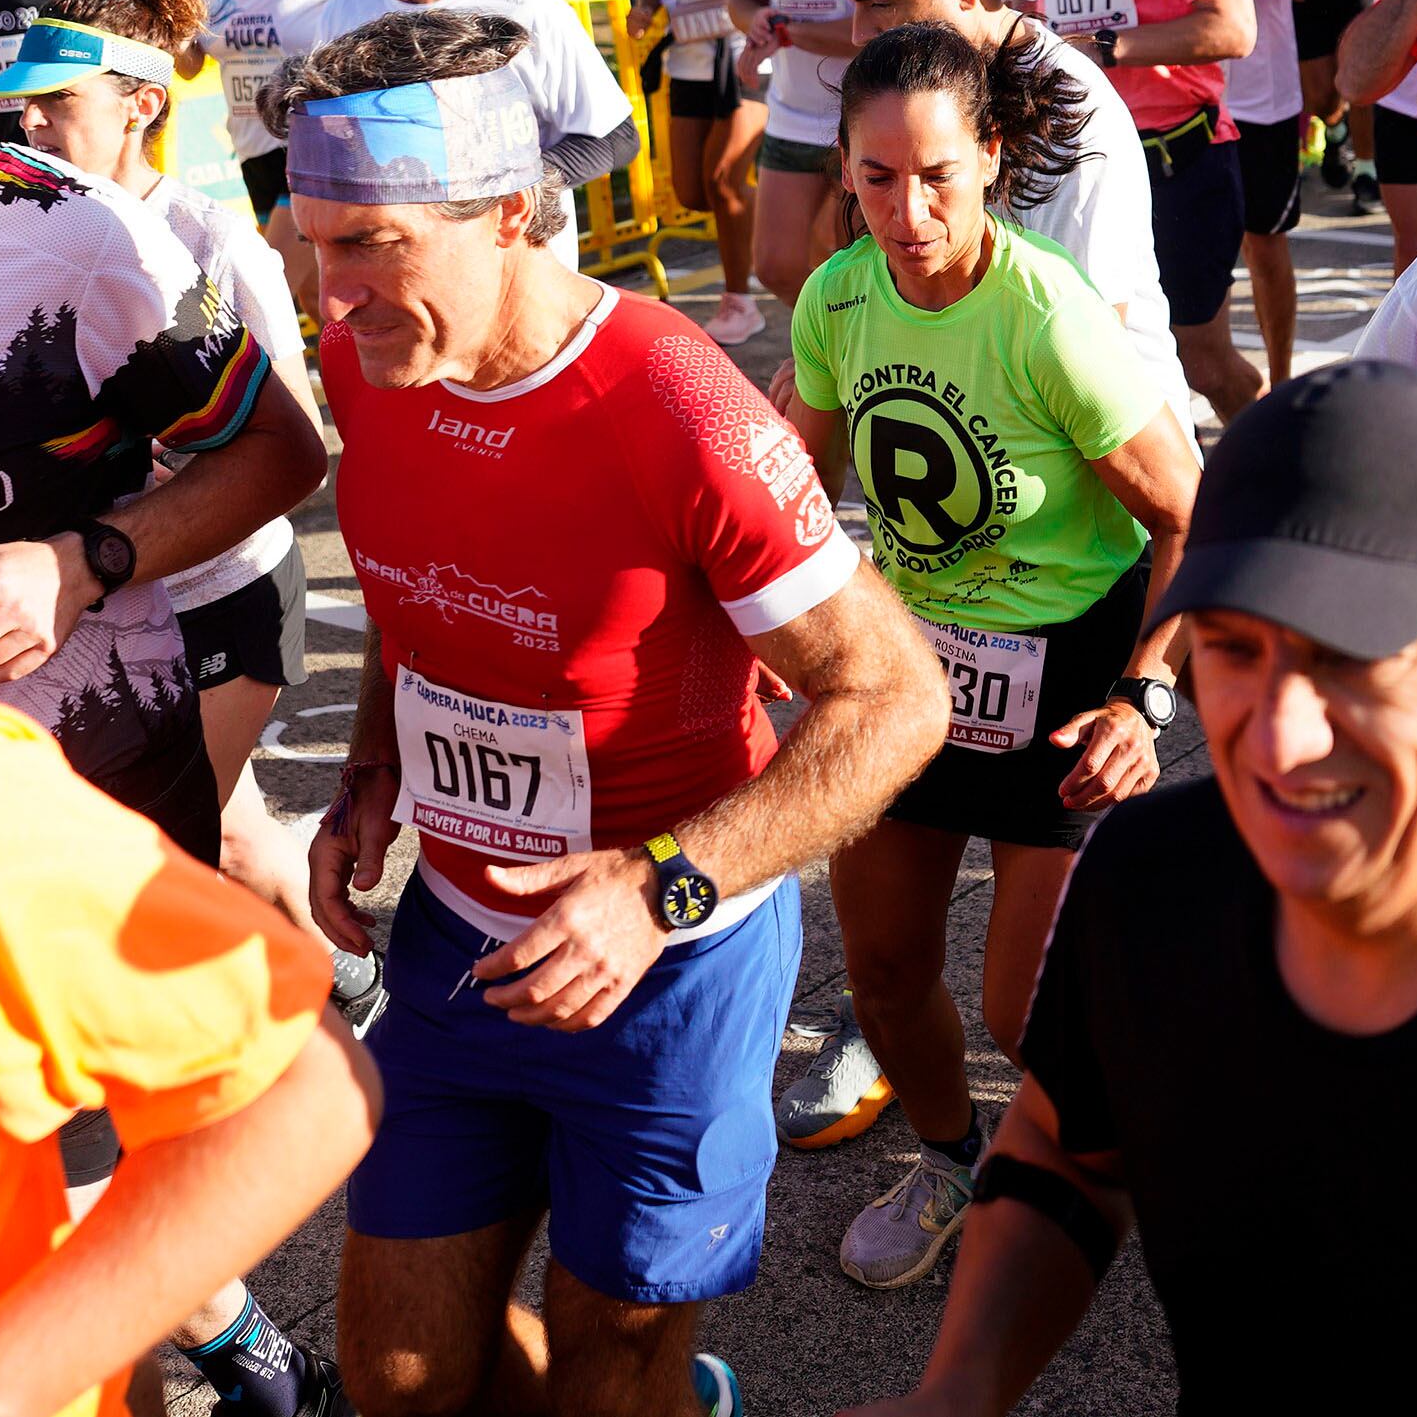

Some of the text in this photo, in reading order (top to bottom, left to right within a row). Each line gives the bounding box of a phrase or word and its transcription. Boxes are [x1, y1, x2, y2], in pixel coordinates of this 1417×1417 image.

[225, 26, 281, 50] HUCA
[427, 409, 516, 449] land
[851, 363, 1018, 518] CONTRA EL CANCER
[454, 441, 504, 460] EVENTS
[870, 413, 963, 548] R
[896, 524, 1008, 575] SOLIDARIO
[450, 590, 465, 602] de
[512, 631, 561, 652] 2023
[935, 638, 978, 664] ROSINA
[990, 636, 1021, 652] 2023
[417, 680, 548, 730] CARRERA HUCA 2023
[938, 653, 1011, 723] 30
[453, 722, 498, 745] CHEMA
[952, 727, 1010, 747] LA SALUD
[424, 731, 541, 817] 0167
[464, 820, 492, 845] POR
[493, 828, 512, 847] LA
[515, 835, 563, 854] SALUD
[234, 1311, 293, 1374] CEACTIVO
